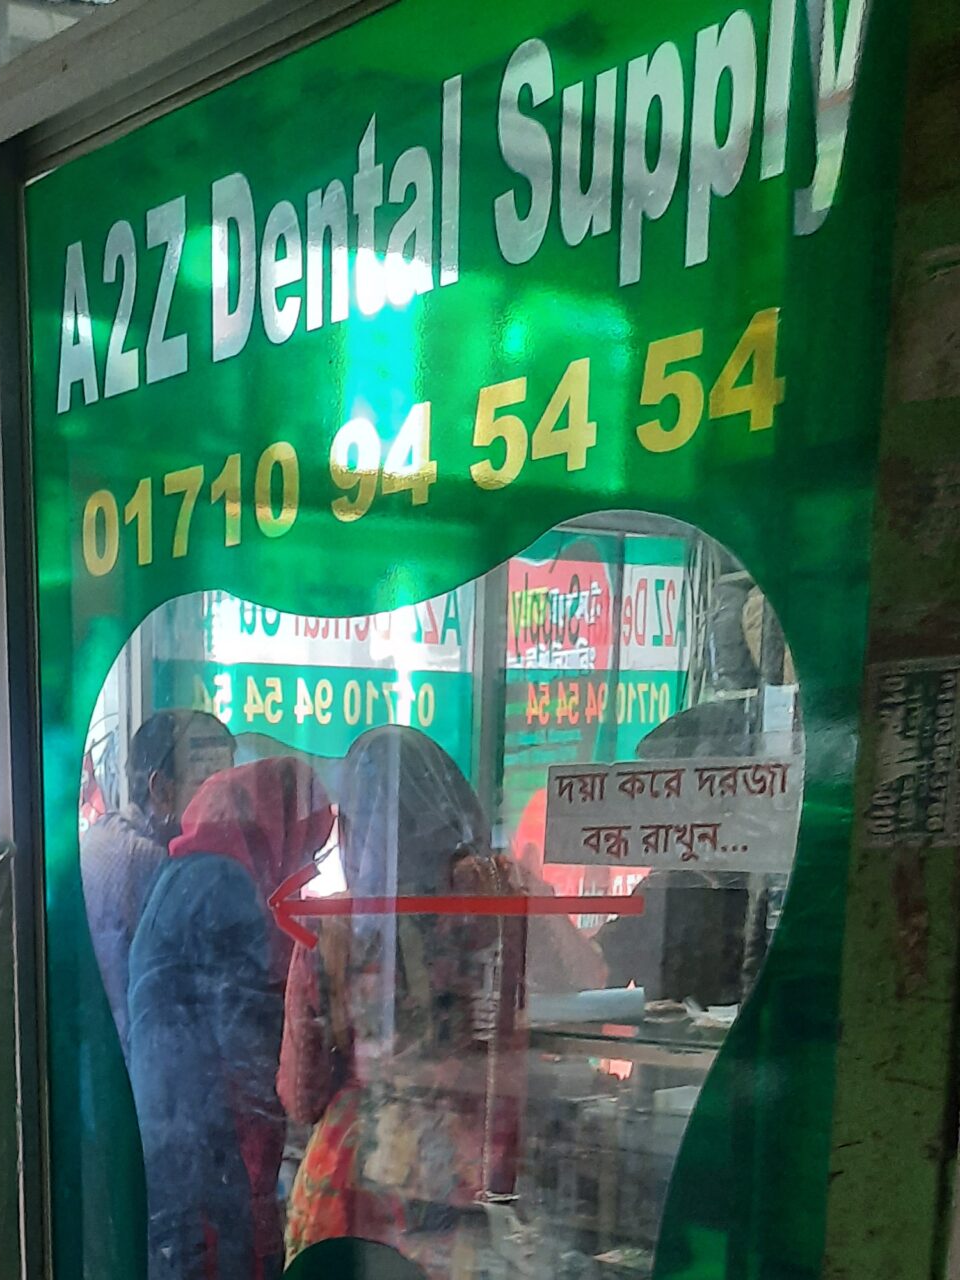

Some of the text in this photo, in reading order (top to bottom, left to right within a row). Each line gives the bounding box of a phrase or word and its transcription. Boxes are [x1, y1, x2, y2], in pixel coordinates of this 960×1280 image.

[57, 0, 869, 413] A2Z Dental Supply
[82, 307, 786, 576] 01710 94 54 54
[555, 762, 792, 804] দয়া করে দরজা
[581, 826, 632, 860] বন্ধ
